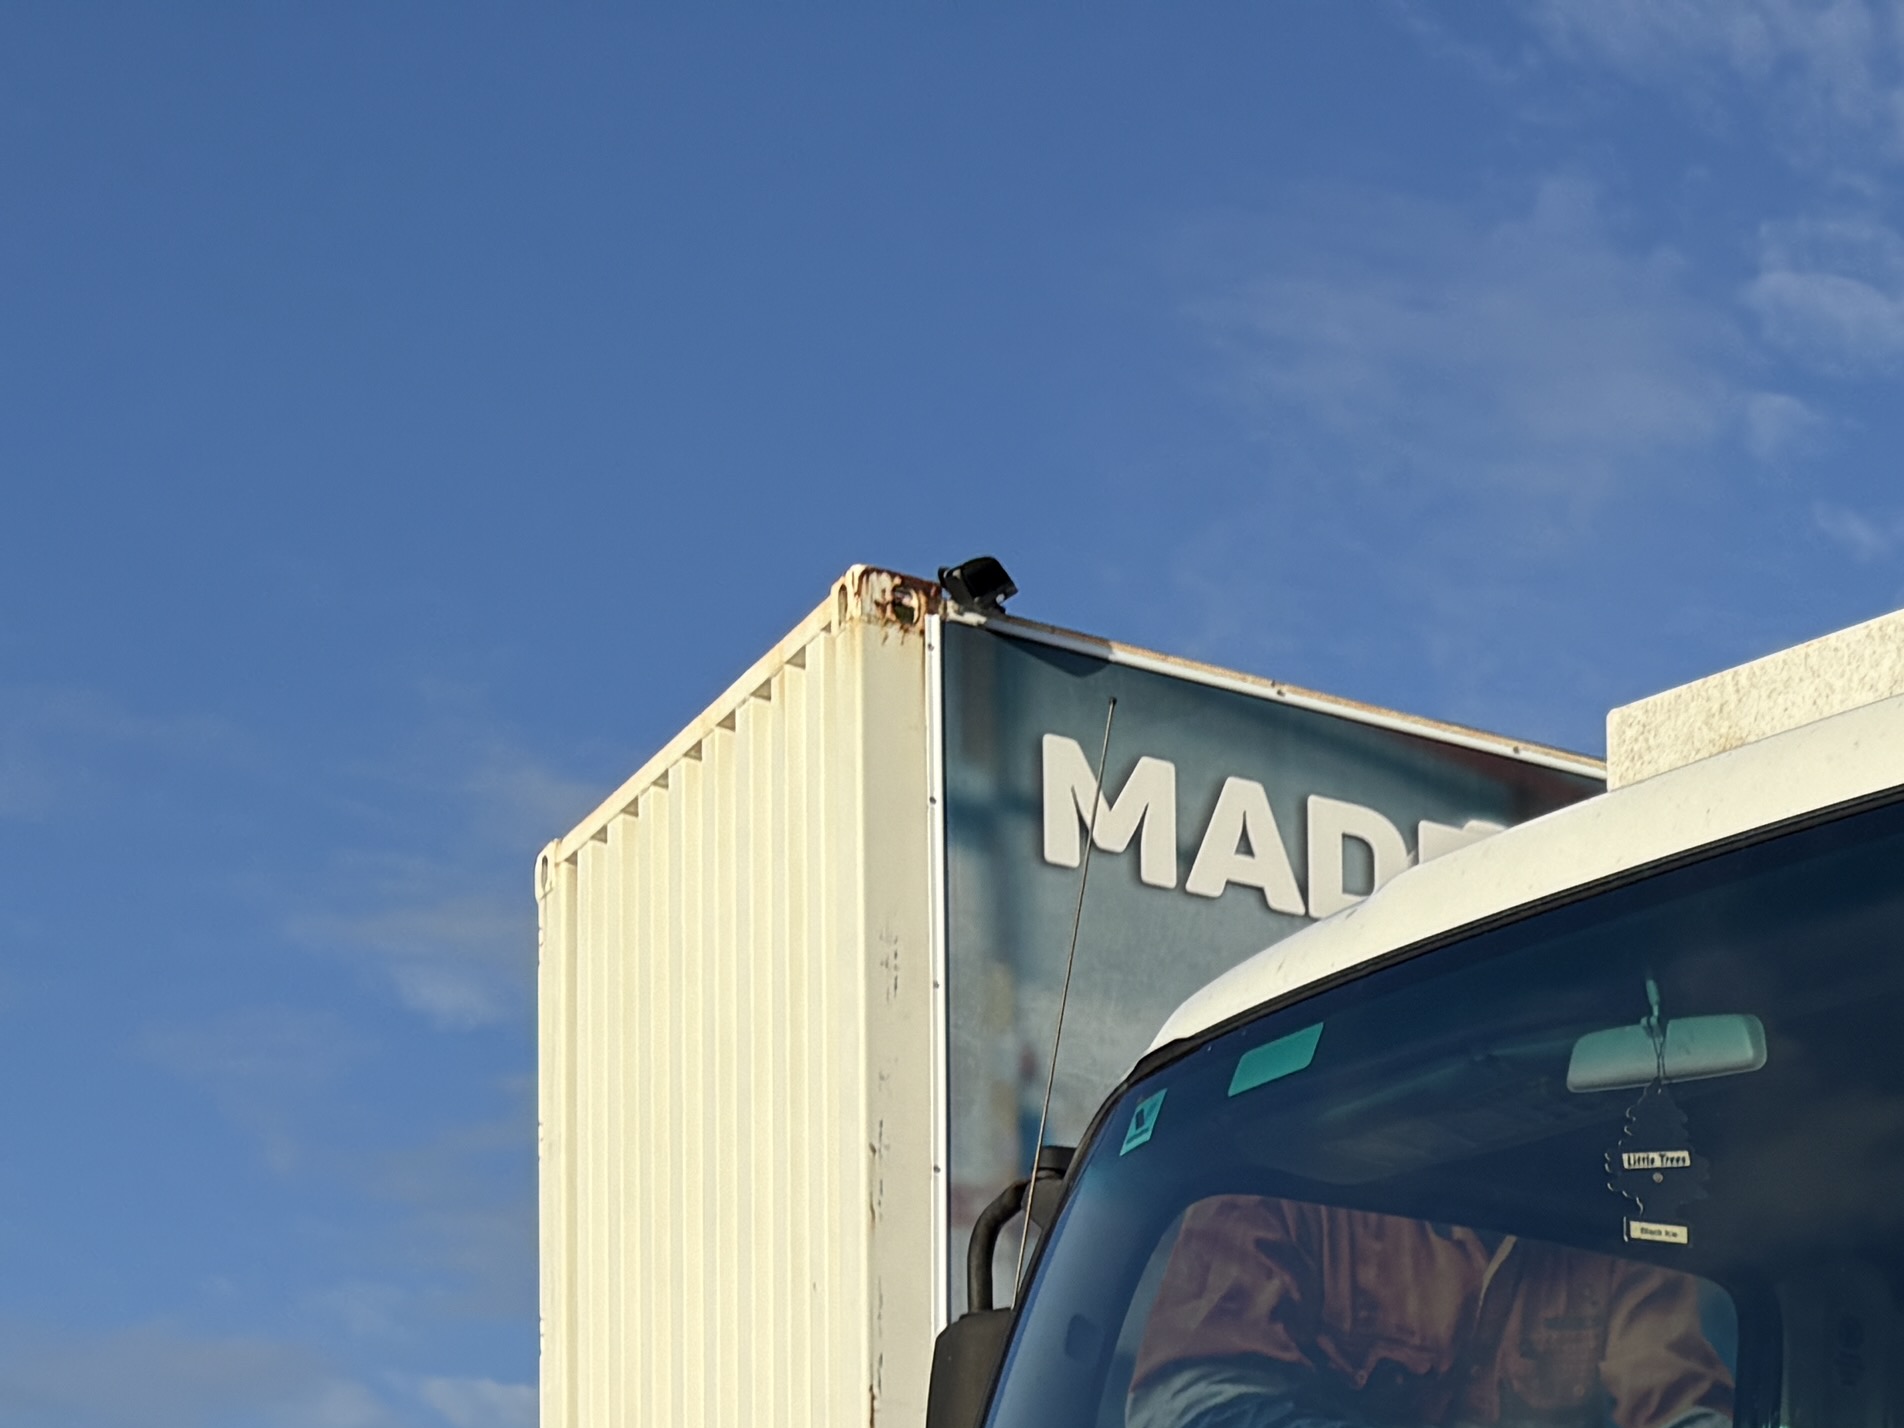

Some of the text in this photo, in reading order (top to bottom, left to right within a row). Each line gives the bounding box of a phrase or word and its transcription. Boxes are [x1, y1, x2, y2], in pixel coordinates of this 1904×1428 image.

[1041, 733, 1510, 920] MAD
[1627, 1153, 1686, 1168] Little Trees
